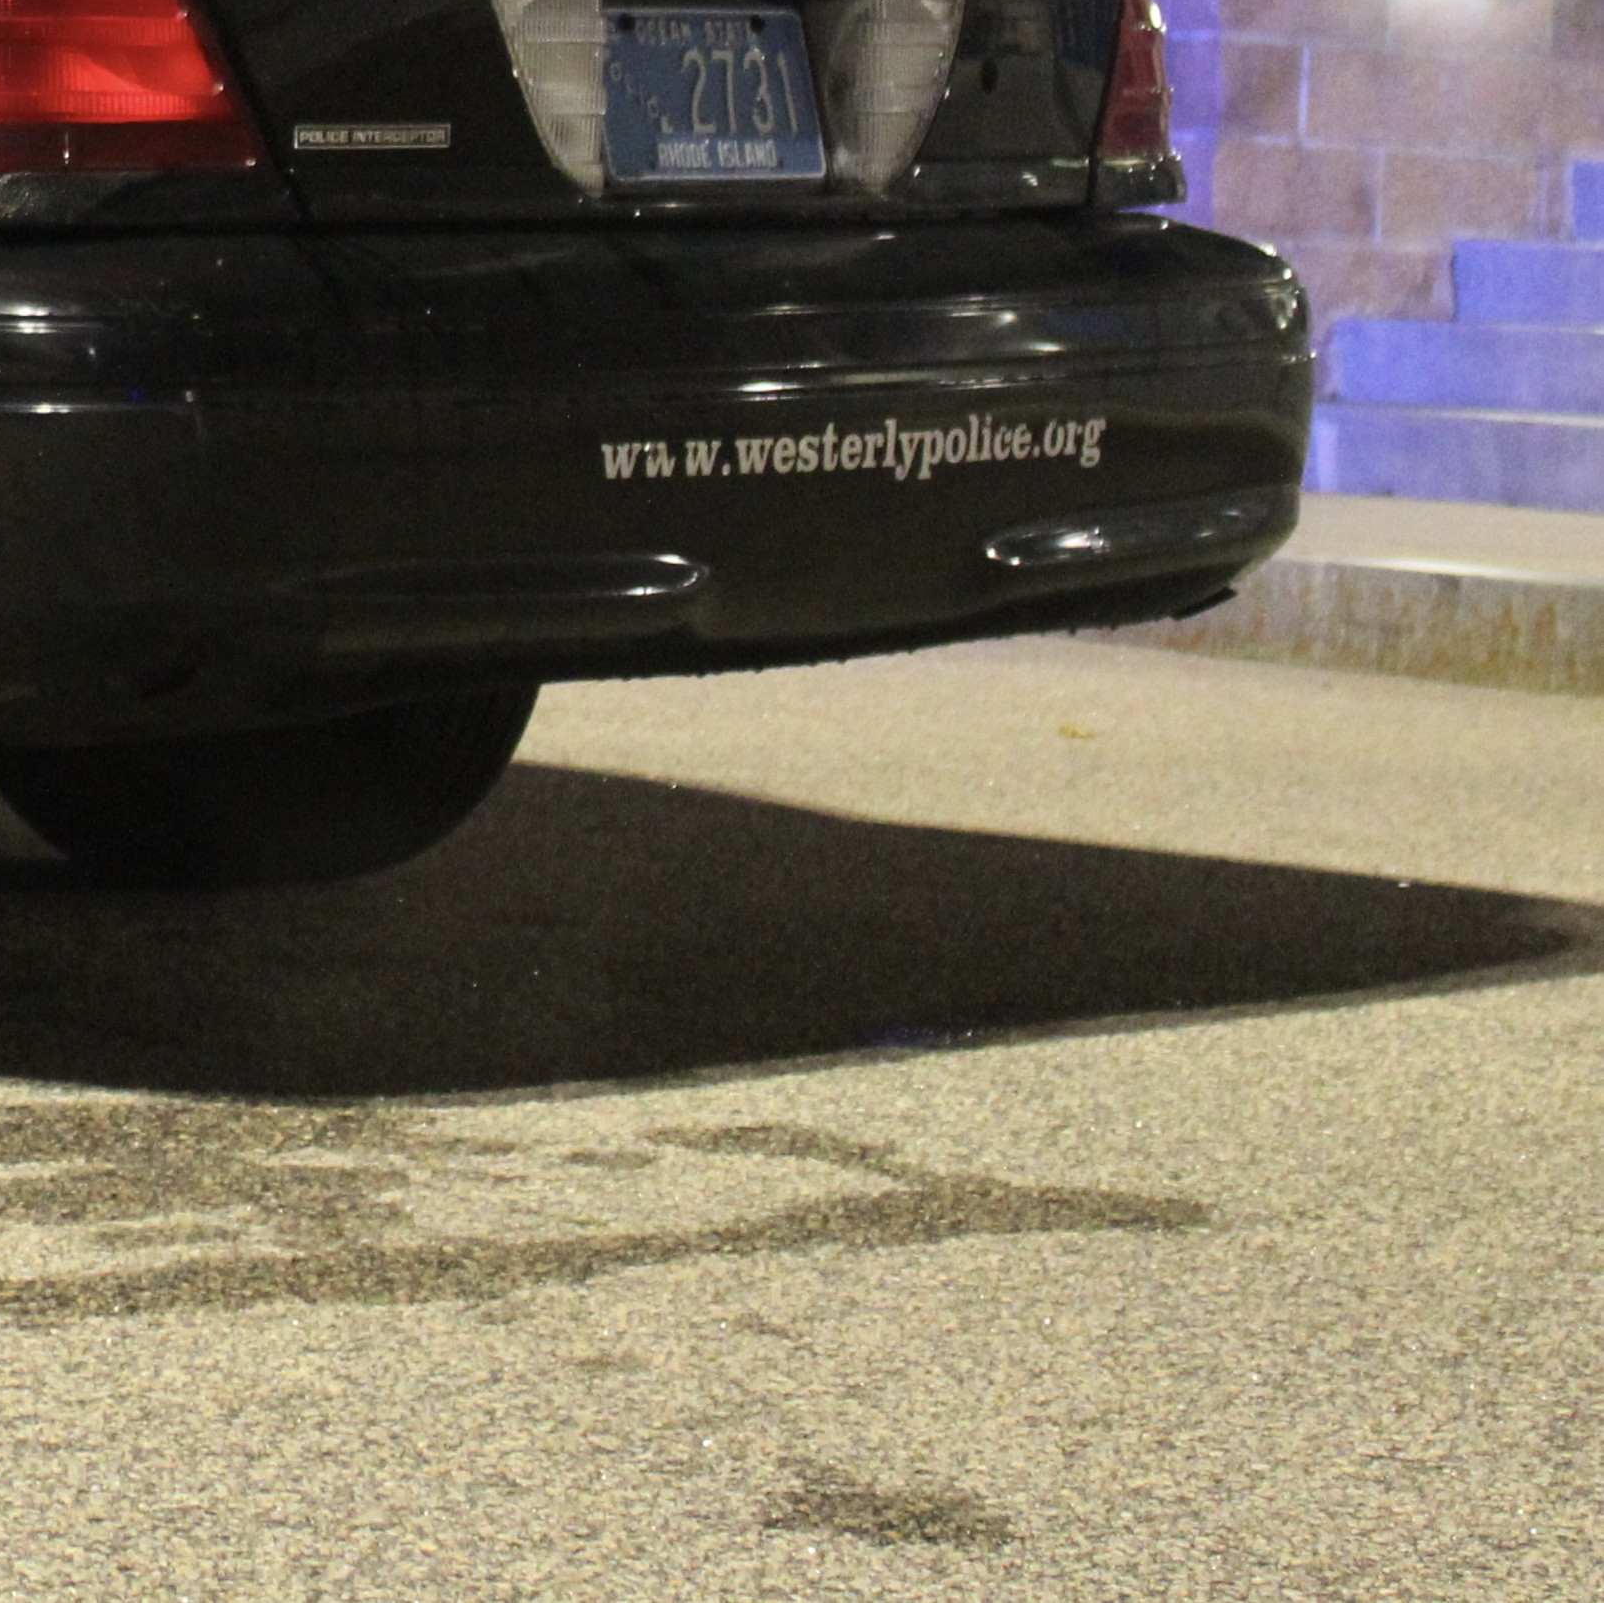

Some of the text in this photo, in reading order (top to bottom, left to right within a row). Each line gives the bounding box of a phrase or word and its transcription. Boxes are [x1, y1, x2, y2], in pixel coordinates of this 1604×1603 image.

[683, 48, 798, 134] 2731
[299, 128, 445, 144] POLICE INTERCEPTOR
[659, 140, 778, 169] RHODE ISLAND
[601, 412, 1107, 483] www.westerlypolice.org
